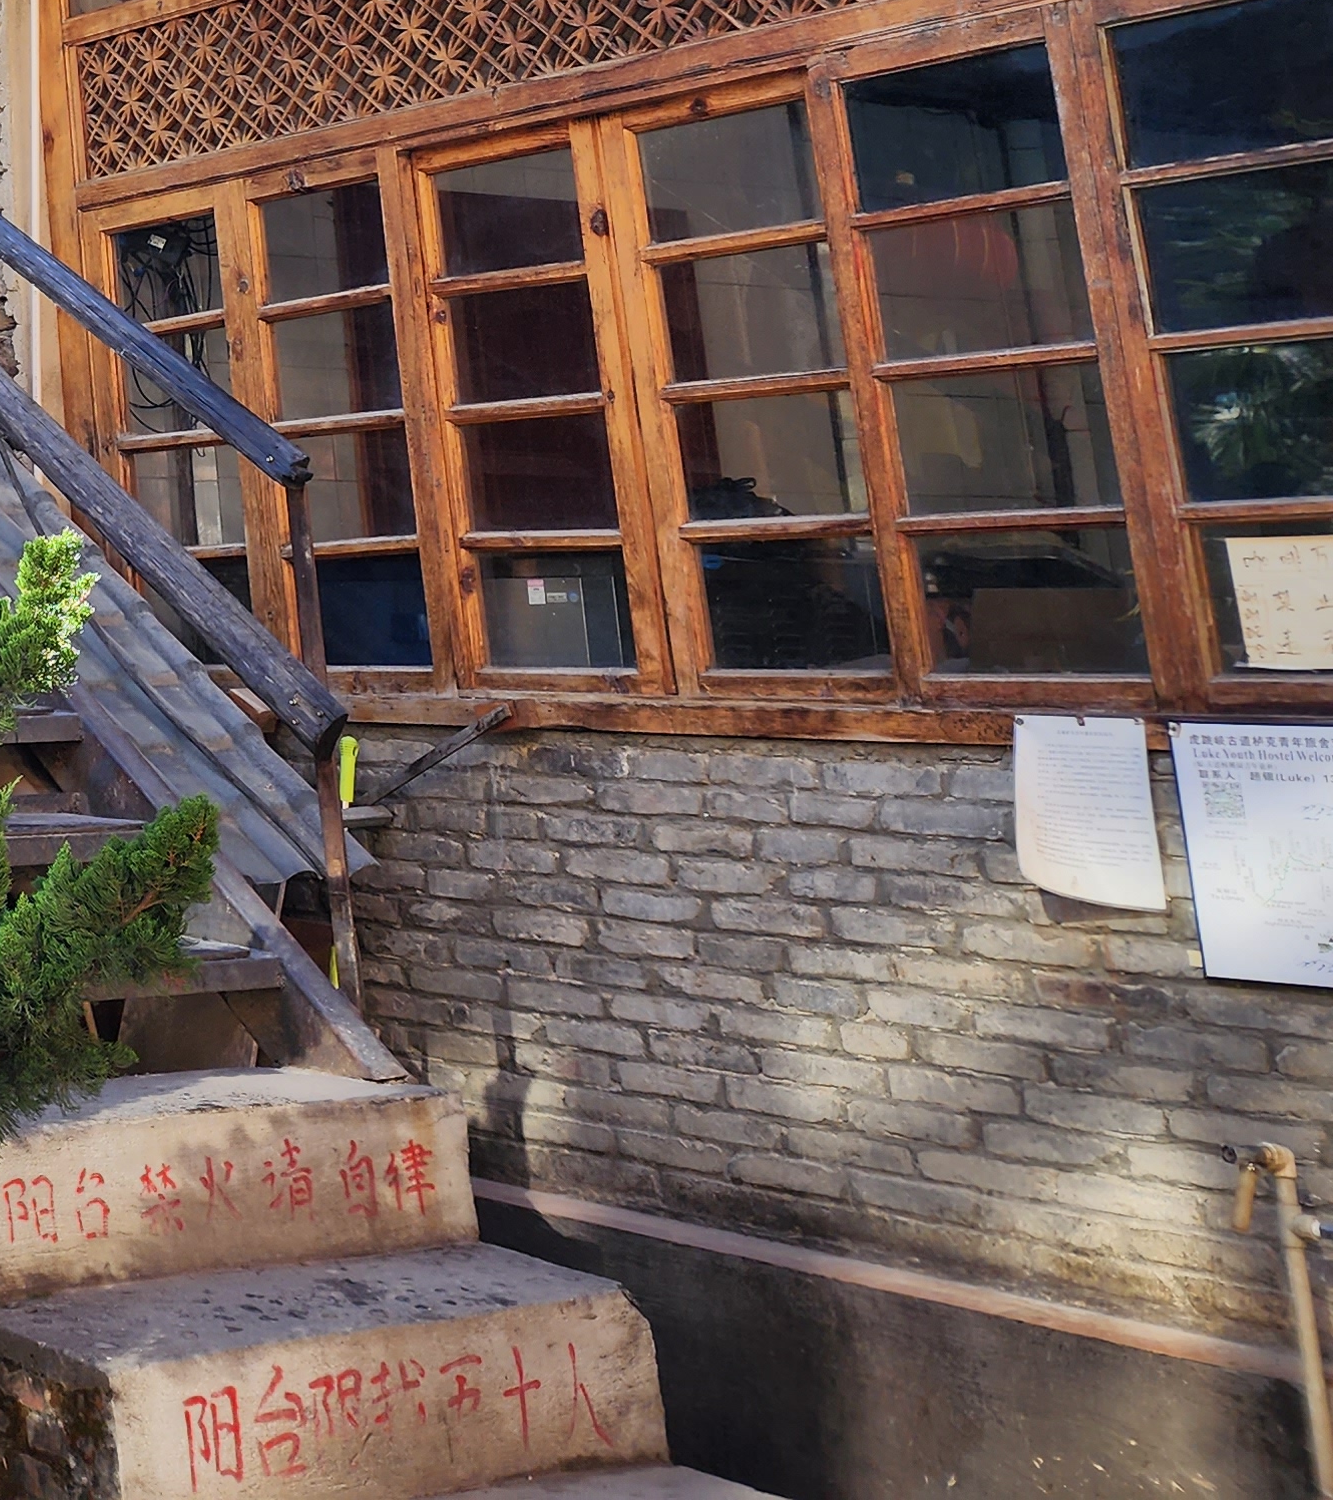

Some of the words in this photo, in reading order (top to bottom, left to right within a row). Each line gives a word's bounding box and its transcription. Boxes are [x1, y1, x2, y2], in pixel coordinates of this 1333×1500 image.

[1222, 748, 1255, 760] Youth
[1258, 750, 1294, 761] Hostel
[2, 1138, 436, 1244] 阳台禁火请自律
